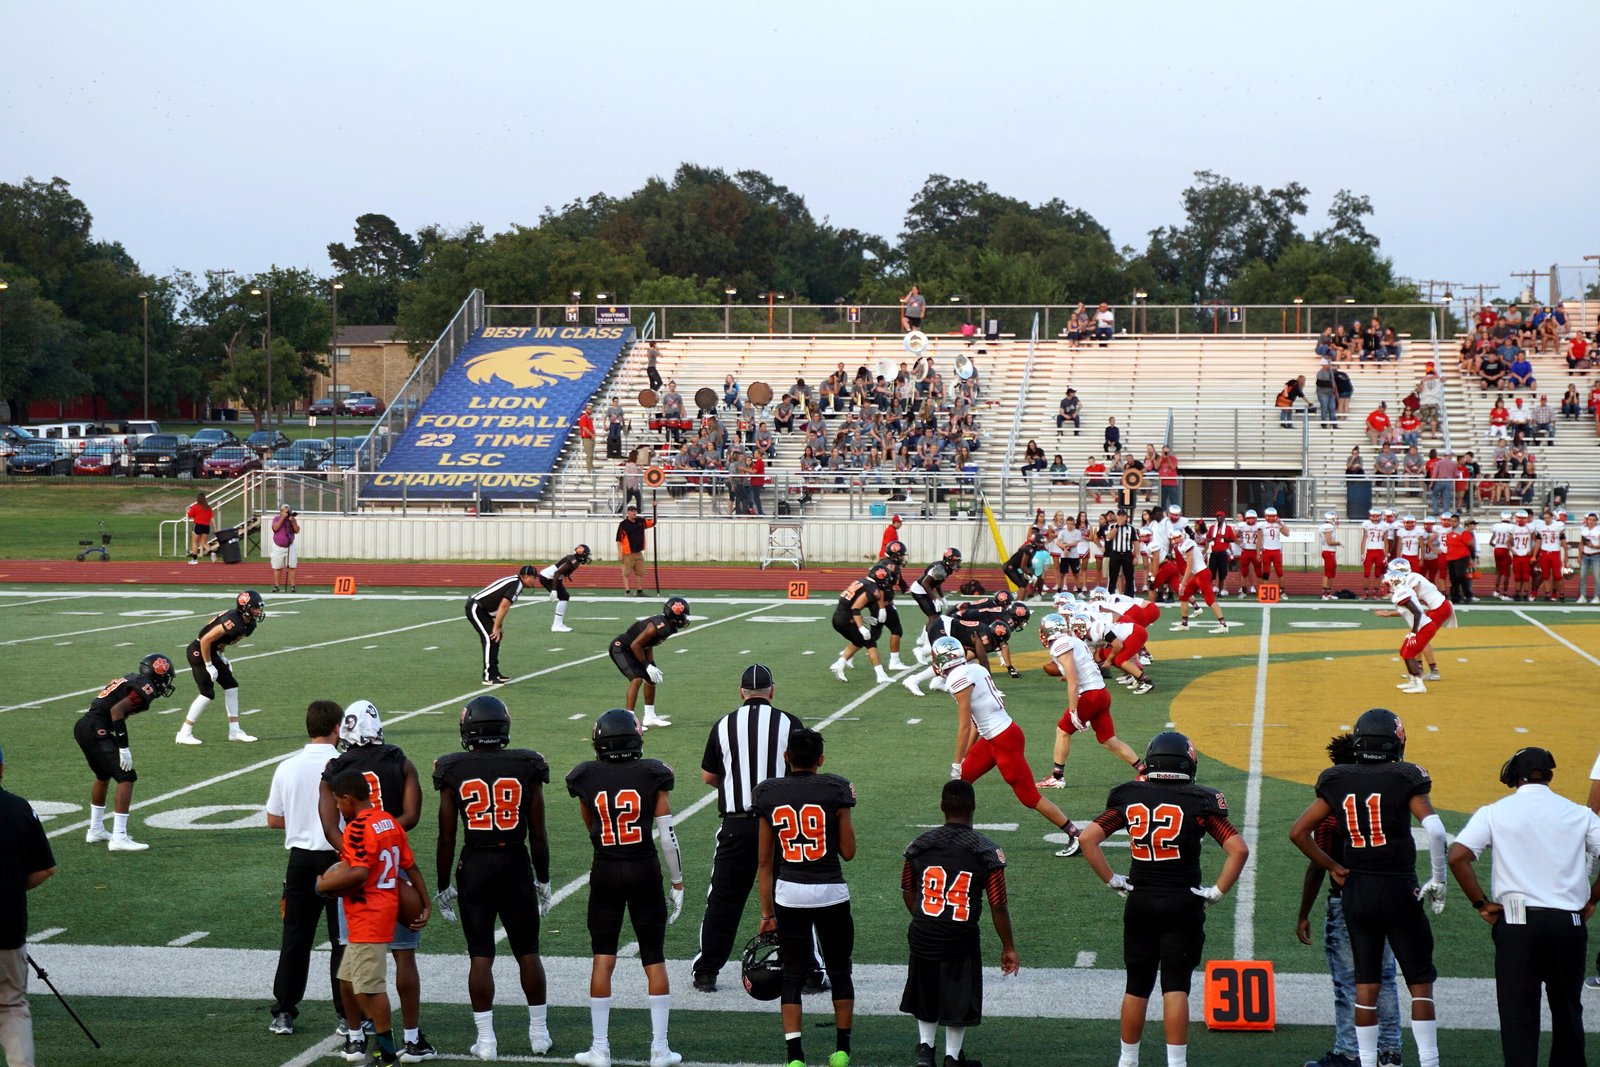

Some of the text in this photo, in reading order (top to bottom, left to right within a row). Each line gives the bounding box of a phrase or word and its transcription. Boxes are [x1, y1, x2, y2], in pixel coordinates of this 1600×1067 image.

[481, 327, 624, 339] BEST IN CLASS
[468, 397, 547, 409] LION
[416, 415, 570, 428] FOOTBALL
[415, 434, 554, 447] 23 TIME
[438, 453, 506, 466] LSC
[373, 473, 542, 487] CHAMPIONS
[1122, 488, 1130, 505] 1
[1270, 528, 1275, 540] 9
[338, 578, 351, 592] 10
[790, 582, 806, 596] 20
[1261, 586, 1276, 600] 30
[460, 777, 522, 830] 28
[594, 788, 642, 846] 12
[1342, 792, 1386, 848] 11
[772, 804, 827, 862] 29
[1126, 803, 1184, 861] 22
[920, 866, 973, 922] 84
[1212, 968, 1270, 1022] 30
